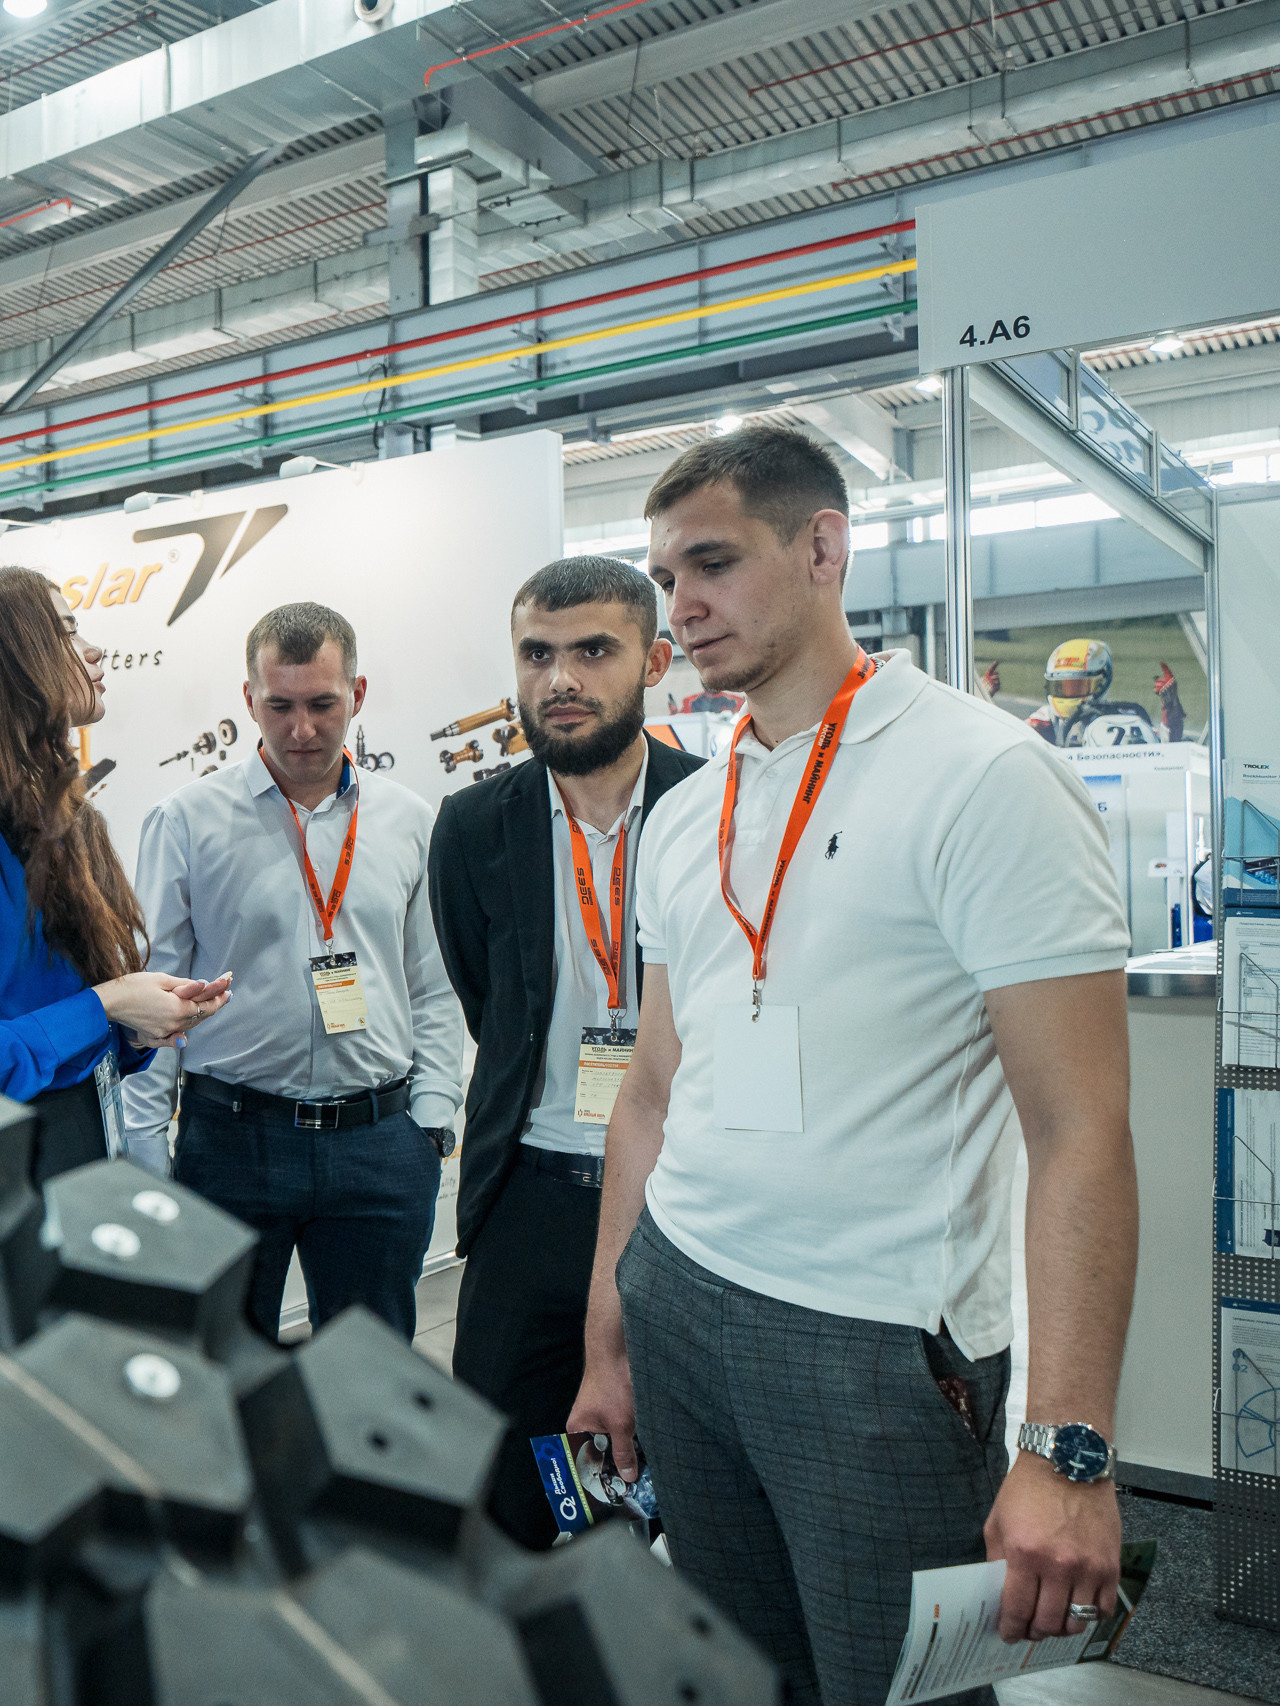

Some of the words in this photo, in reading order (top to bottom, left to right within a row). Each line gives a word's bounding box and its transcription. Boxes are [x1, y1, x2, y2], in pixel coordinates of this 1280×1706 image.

[959, 315, 1031, 347] 4.A6
[60, 562, 163, 611] slar
[99, 647, 163, 671] tters
[803, 760, 824, 804] МАЙНИНГ
[550, 1473, 561, 1495] Дыши
[551, 1457, 566, 1494] Свободно!
